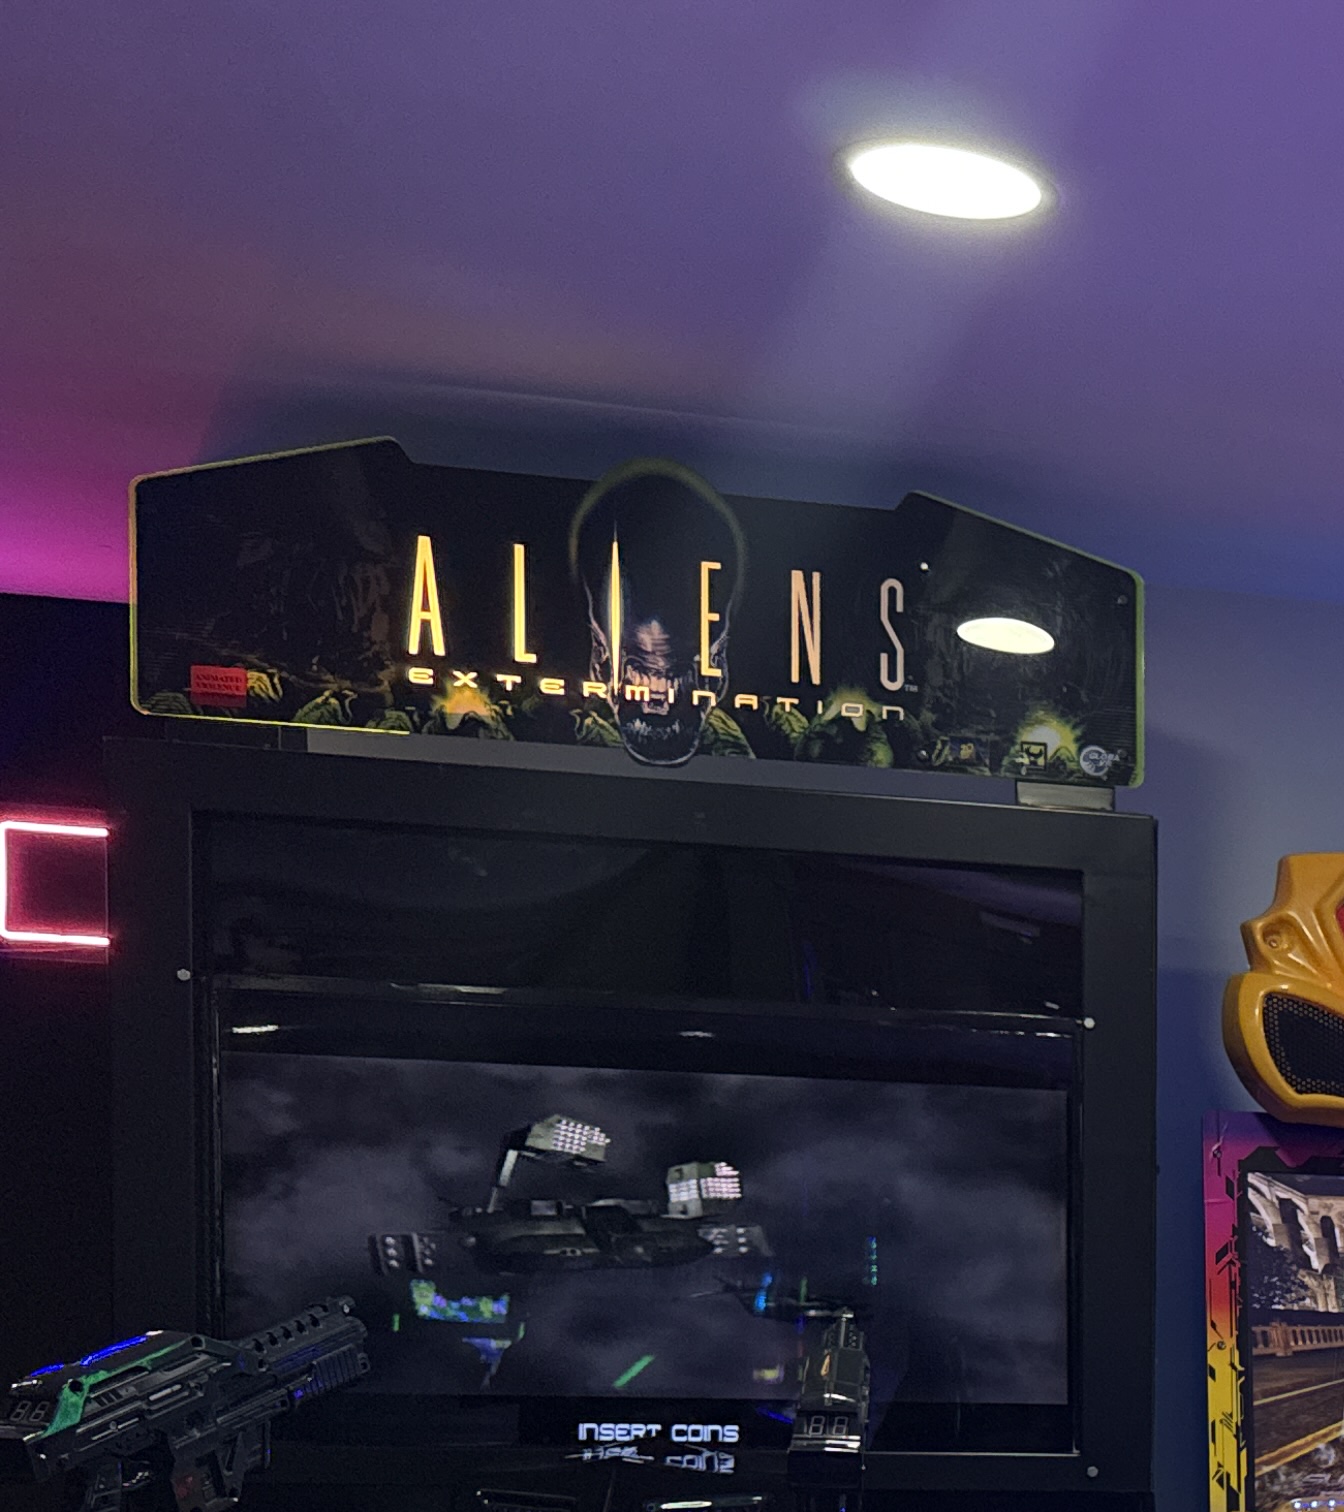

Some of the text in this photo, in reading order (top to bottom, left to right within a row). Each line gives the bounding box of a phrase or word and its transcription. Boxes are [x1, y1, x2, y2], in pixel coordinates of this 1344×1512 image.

[407, 522, 906, 692] ALIENS
[406, 666, 904, 721] EXTERMINATION
[578, 1422, 740, 1443] INSERT COINS
